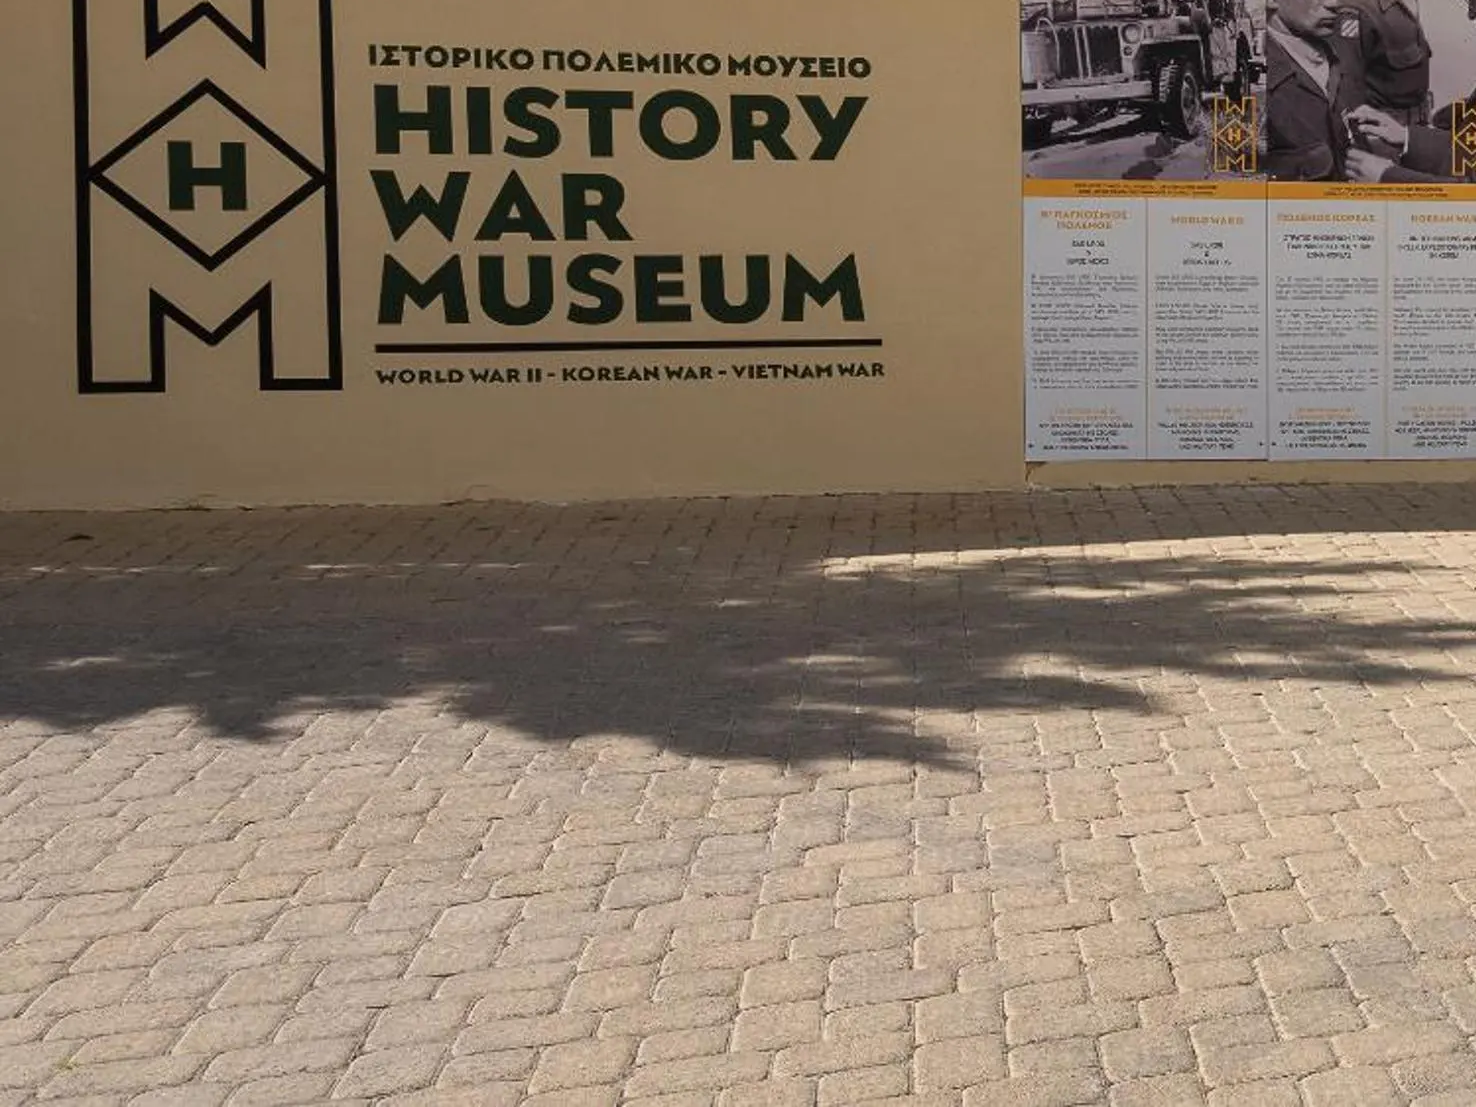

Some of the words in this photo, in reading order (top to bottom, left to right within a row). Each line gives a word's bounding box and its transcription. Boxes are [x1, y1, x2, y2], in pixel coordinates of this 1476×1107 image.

[369, 44, 534, 71] ΙΣΤΟΡΙΚΟ
[543, 50, 722, 76] ΠΟΛΕΜΙΚΟ
[728, 55, 872, 79] ΜΟΥΣΕΙΟ
[374, 84, 869, 161] HISTORY
[167, 141, 248, 212] H
[370, 169, 634, 243] WAR
[378, 254, 865, 326] MUSEUM
[376, 369, 464, 385] WORLD
[469, 369, 522, 383] WAR
[526, 368, 542, 383] II
[562, 366, 660, 382] KOREAN
[665, 366, 713, 380] WAR
[732, 364, 833, 380] VIETNAM
[837, 362, 885, 377] WAR
